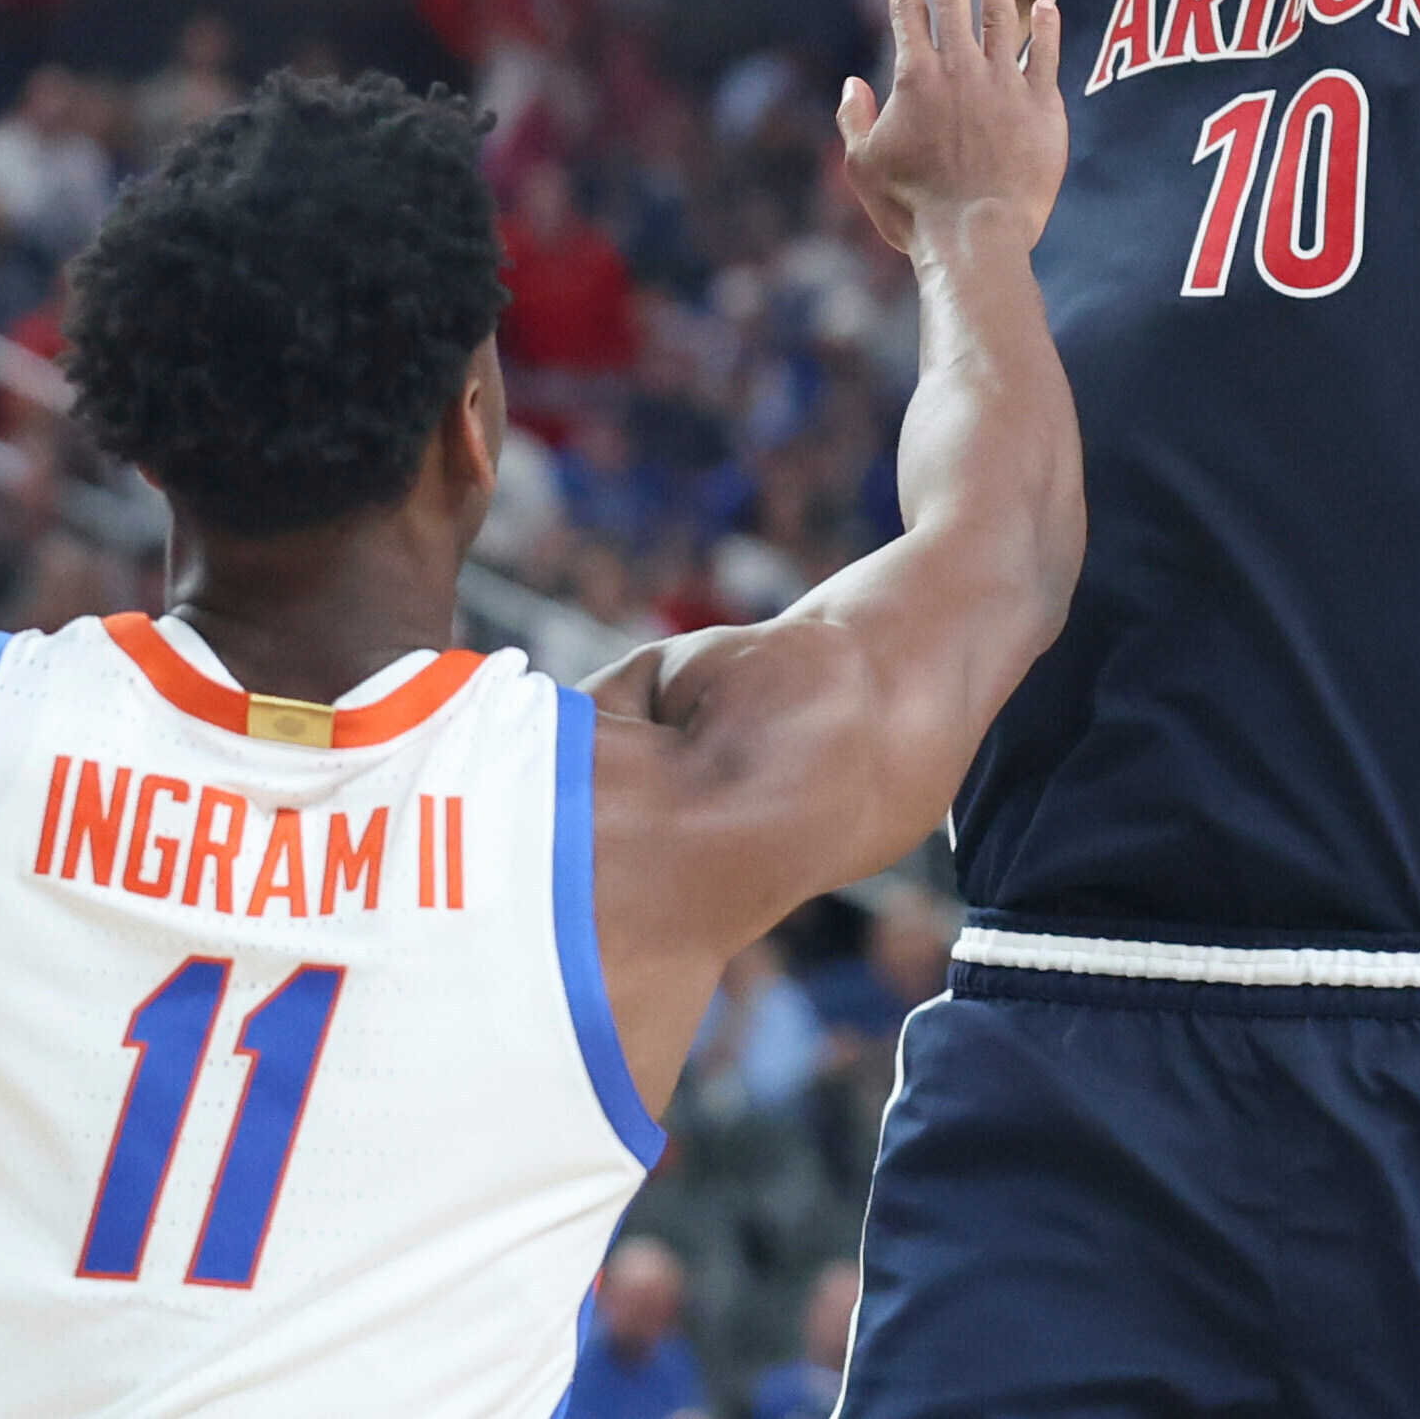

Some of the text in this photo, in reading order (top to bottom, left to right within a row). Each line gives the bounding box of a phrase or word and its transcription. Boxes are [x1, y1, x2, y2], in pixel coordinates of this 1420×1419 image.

[1181, 67, 1370, 298] 10
[33, 755, 464, 918] INGRAM II
[75, 954, 348, 1290] 11
